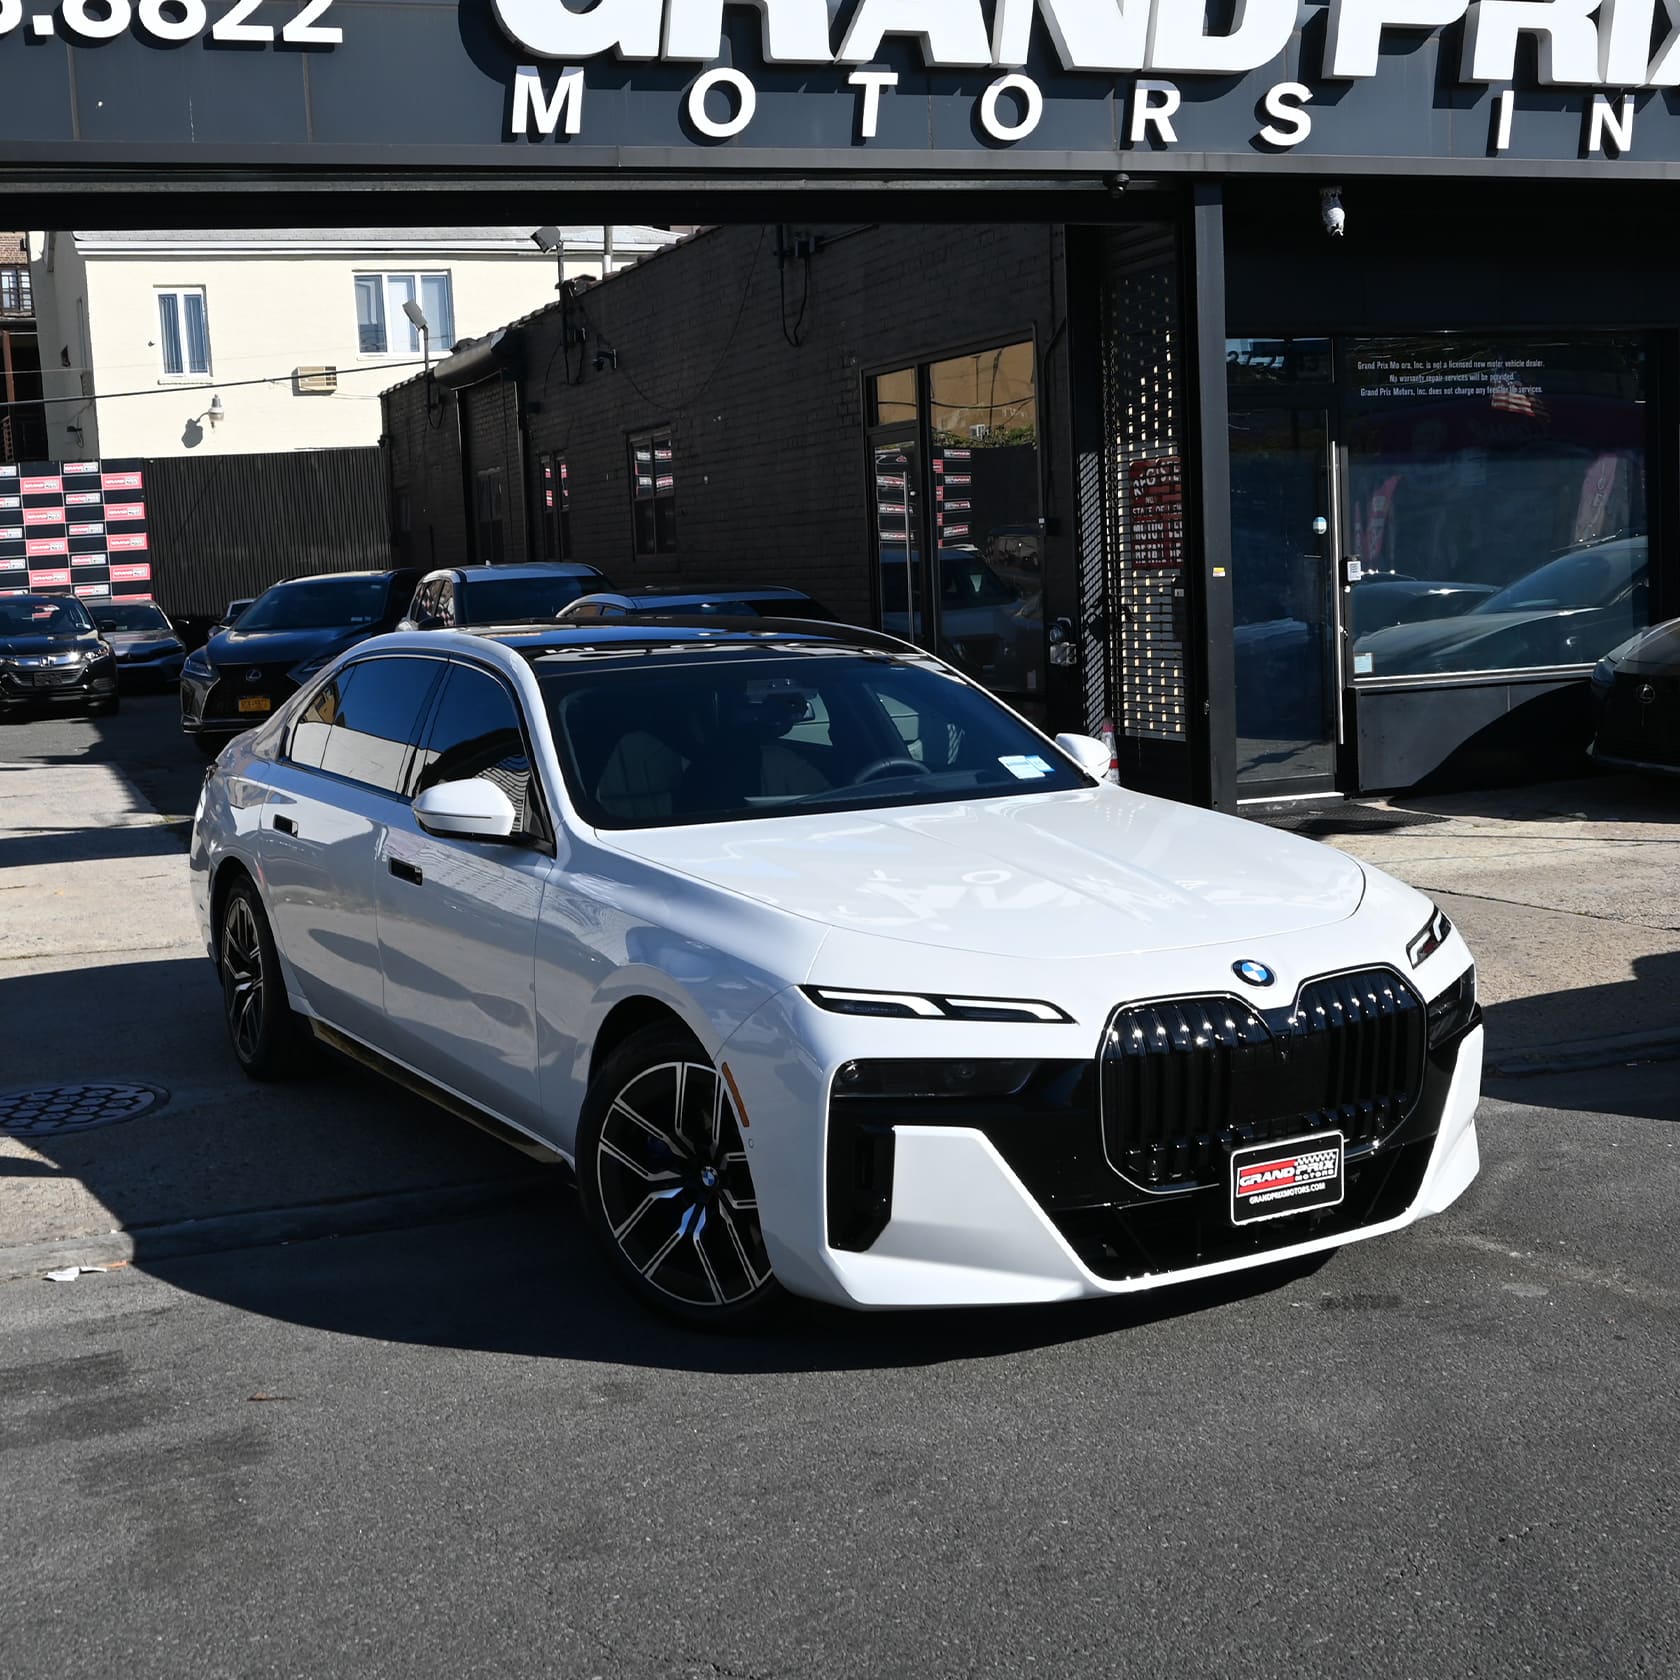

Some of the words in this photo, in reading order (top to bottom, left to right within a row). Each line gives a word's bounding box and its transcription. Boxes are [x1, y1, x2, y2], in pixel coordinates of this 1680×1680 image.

[511, 65, 1314, 147] MOTORS
[1357, 360, 1376, 370] Grand
[1376, 360, 1389, 370] Prix
[1389, 360, 1412, 370] Moors,
[1448, 359, 1473, 369] licensed
[1473, 361, 1486, 369] new
[1360, 387, 1379, 396] Grand
[1379, 387, 1392, 396] Prix
[1392, 387, 1416, 396] Motors,
[1416, 386, 1428, 396] Inc.
[1454, 387, 1475, 396] charge
[1239, 1165, 1296, 1187] GRAND
[1295, 1159, 1335, 1175] PRIX
[1294, 1168, 1335, 1182] MOTORS
